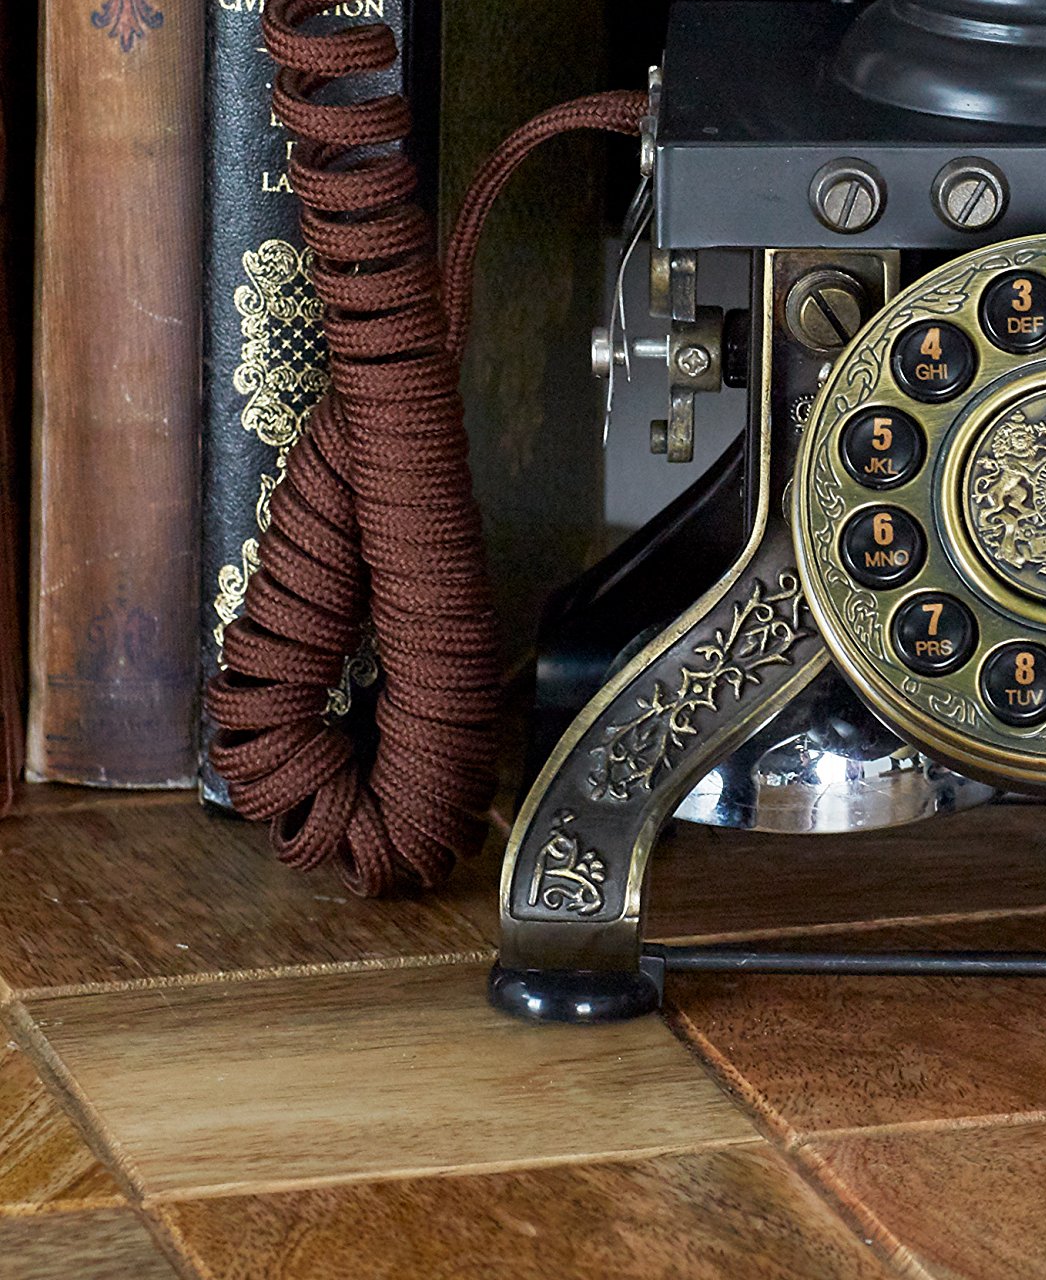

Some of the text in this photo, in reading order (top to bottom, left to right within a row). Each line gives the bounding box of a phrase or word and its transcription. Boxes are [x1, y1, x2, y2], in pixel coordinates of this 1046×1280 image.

[1012, 279, 1032, 311] 3
[1007, 317, 1044, 333] DEF
[921, 328, 942, 360] 4
[915, 364, 948, 381] GHI
[872, 418, 893, 450] 5
[864, 457, 898, 474] JKL
[873, 512, 894, 545] 6
[864, 550, 909, 568] MNO
[922, 604, 944, 635] 7
[915, 640, 953, 656] PRS
[1015, 652, 1035, 684] 8
[1005, 689, 1043, 706] TUV
